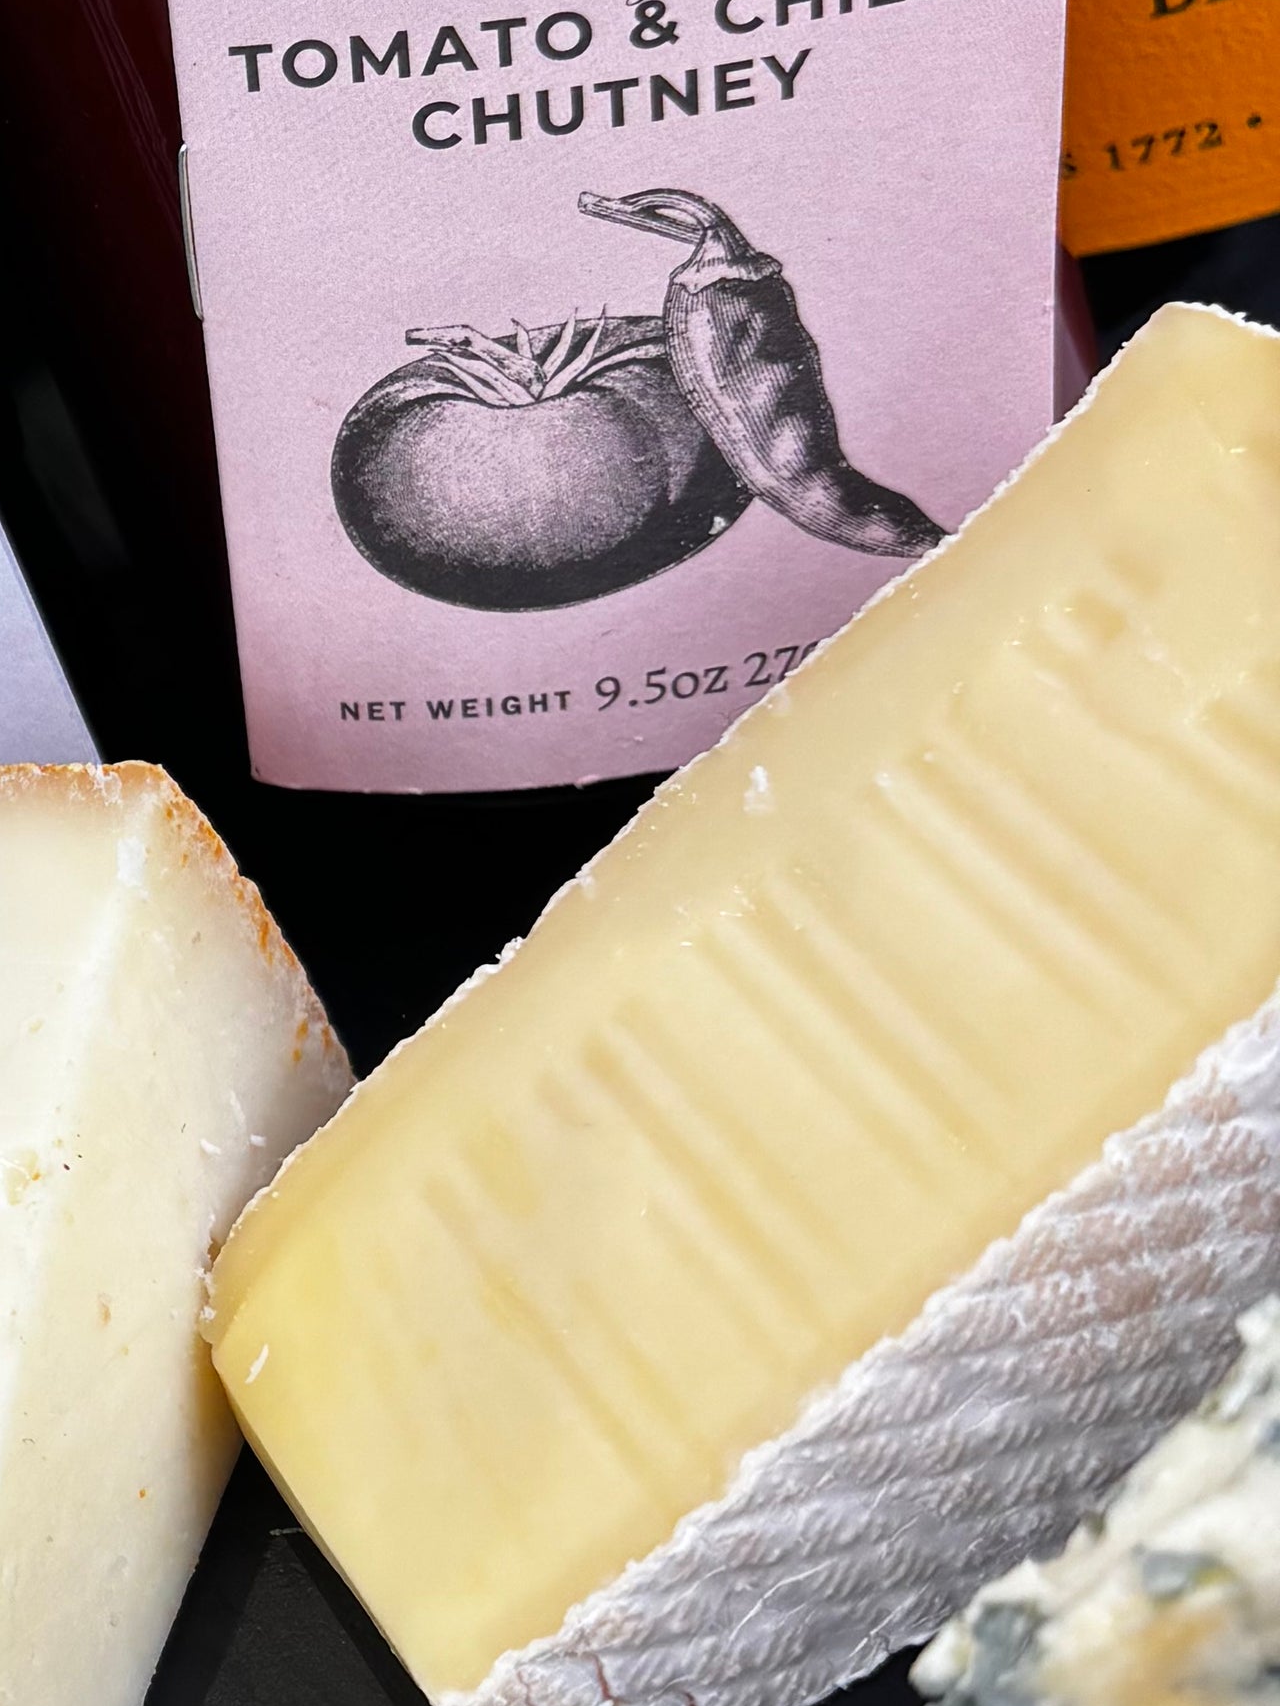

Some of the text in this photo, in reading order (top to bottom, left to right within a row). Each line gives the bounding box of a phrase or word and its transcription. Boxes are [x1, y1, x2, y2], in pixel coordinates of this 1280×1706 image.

[229, 12, 592, 92] TOMATO
[628, 2, 682, 50] &
[413, 49, 811, 149] CHUTNEY
[1104, 121, 1224, 173] 1772
[341, 702, 405, 721] NET
[427, 691, 570, 719] WEIGHT
